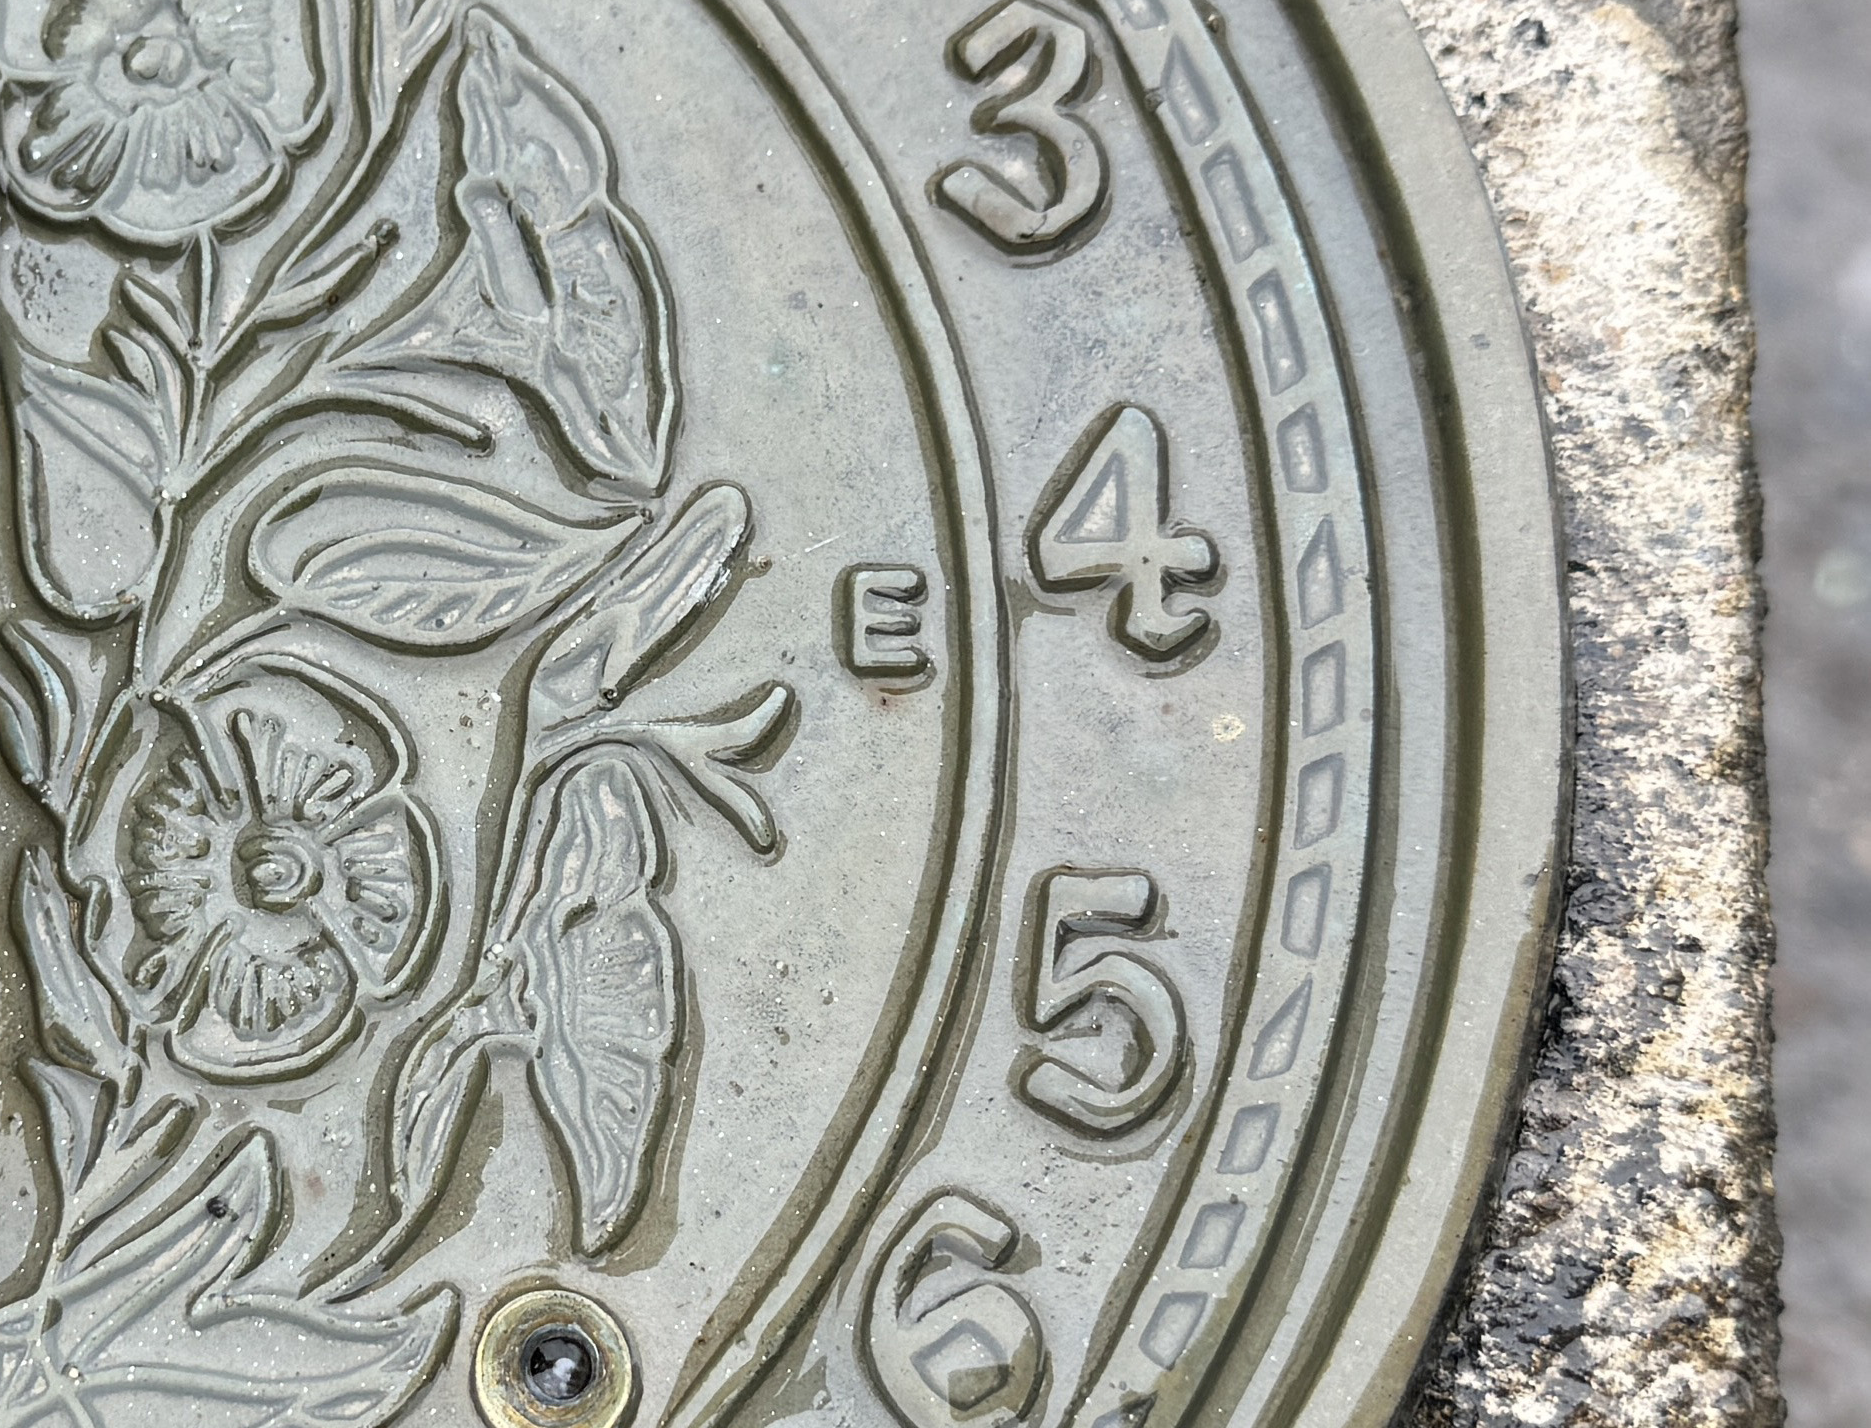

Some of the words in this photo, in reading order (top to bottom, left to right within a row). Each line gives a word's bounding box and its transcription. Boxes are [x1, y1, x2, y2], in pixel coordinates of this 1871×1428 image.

[840, 562, 930, 676] E
[1028, 400, 1222, 664] 4
[1014, 866, 1190, 1142] 5
